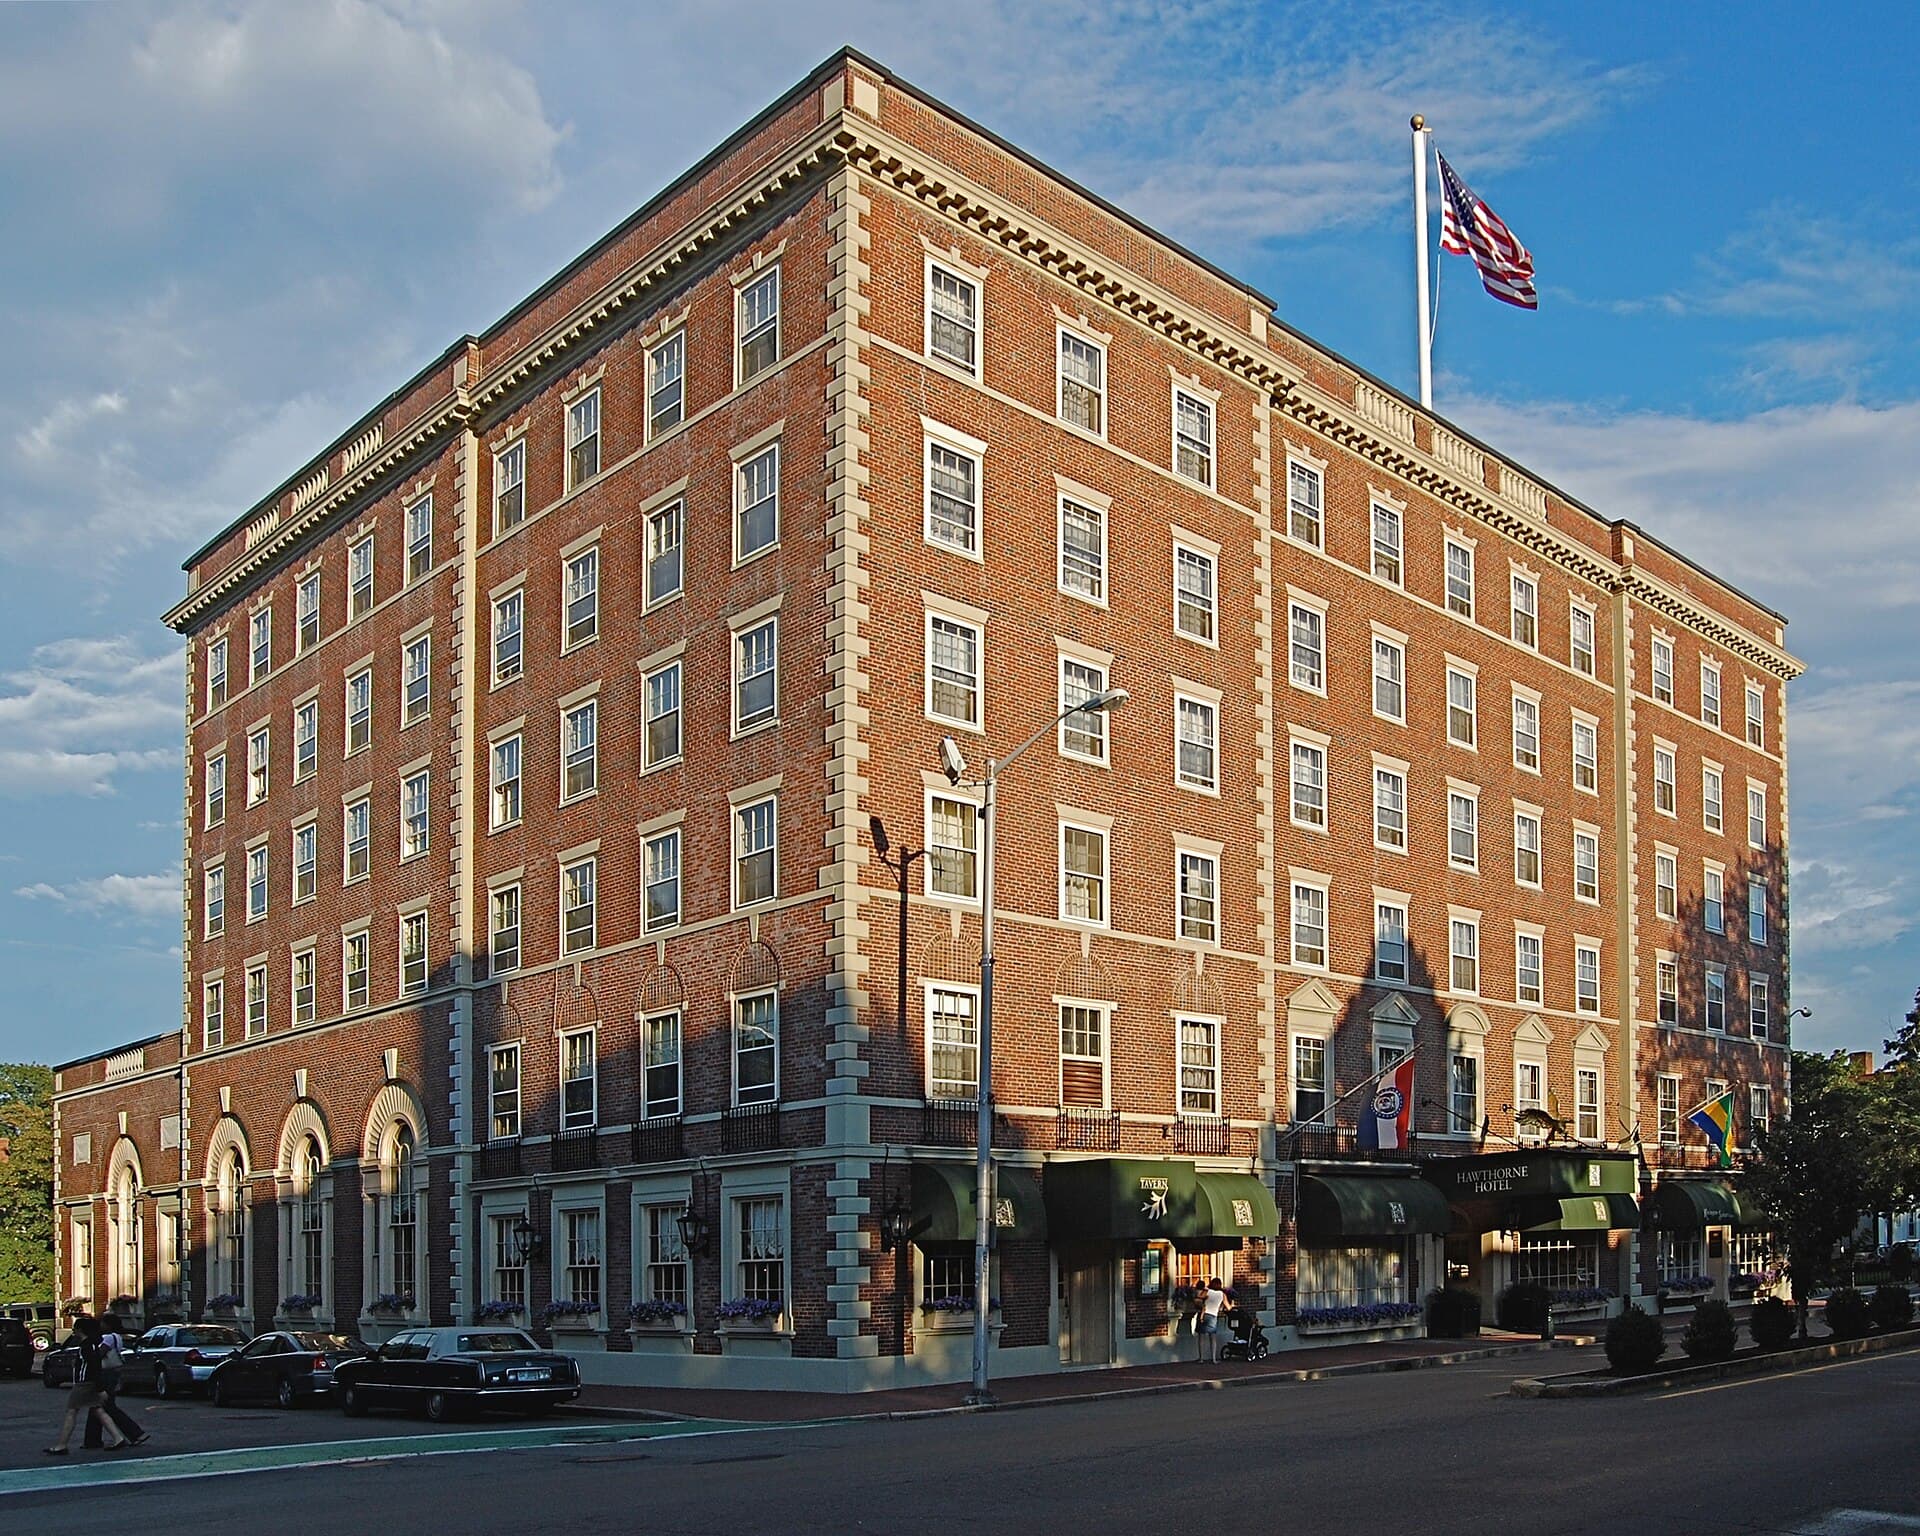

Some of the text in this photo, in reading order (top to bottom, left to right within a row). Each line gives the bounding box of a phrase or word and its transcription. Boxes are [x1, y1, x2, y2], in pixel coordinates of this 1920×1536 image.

[1457, 1166, 1528, 1184] HAWTHORNE
[1140, 1178, 1168, 1189] TAVERN
[1475, 1179, 1512, 1192] HOTEL
